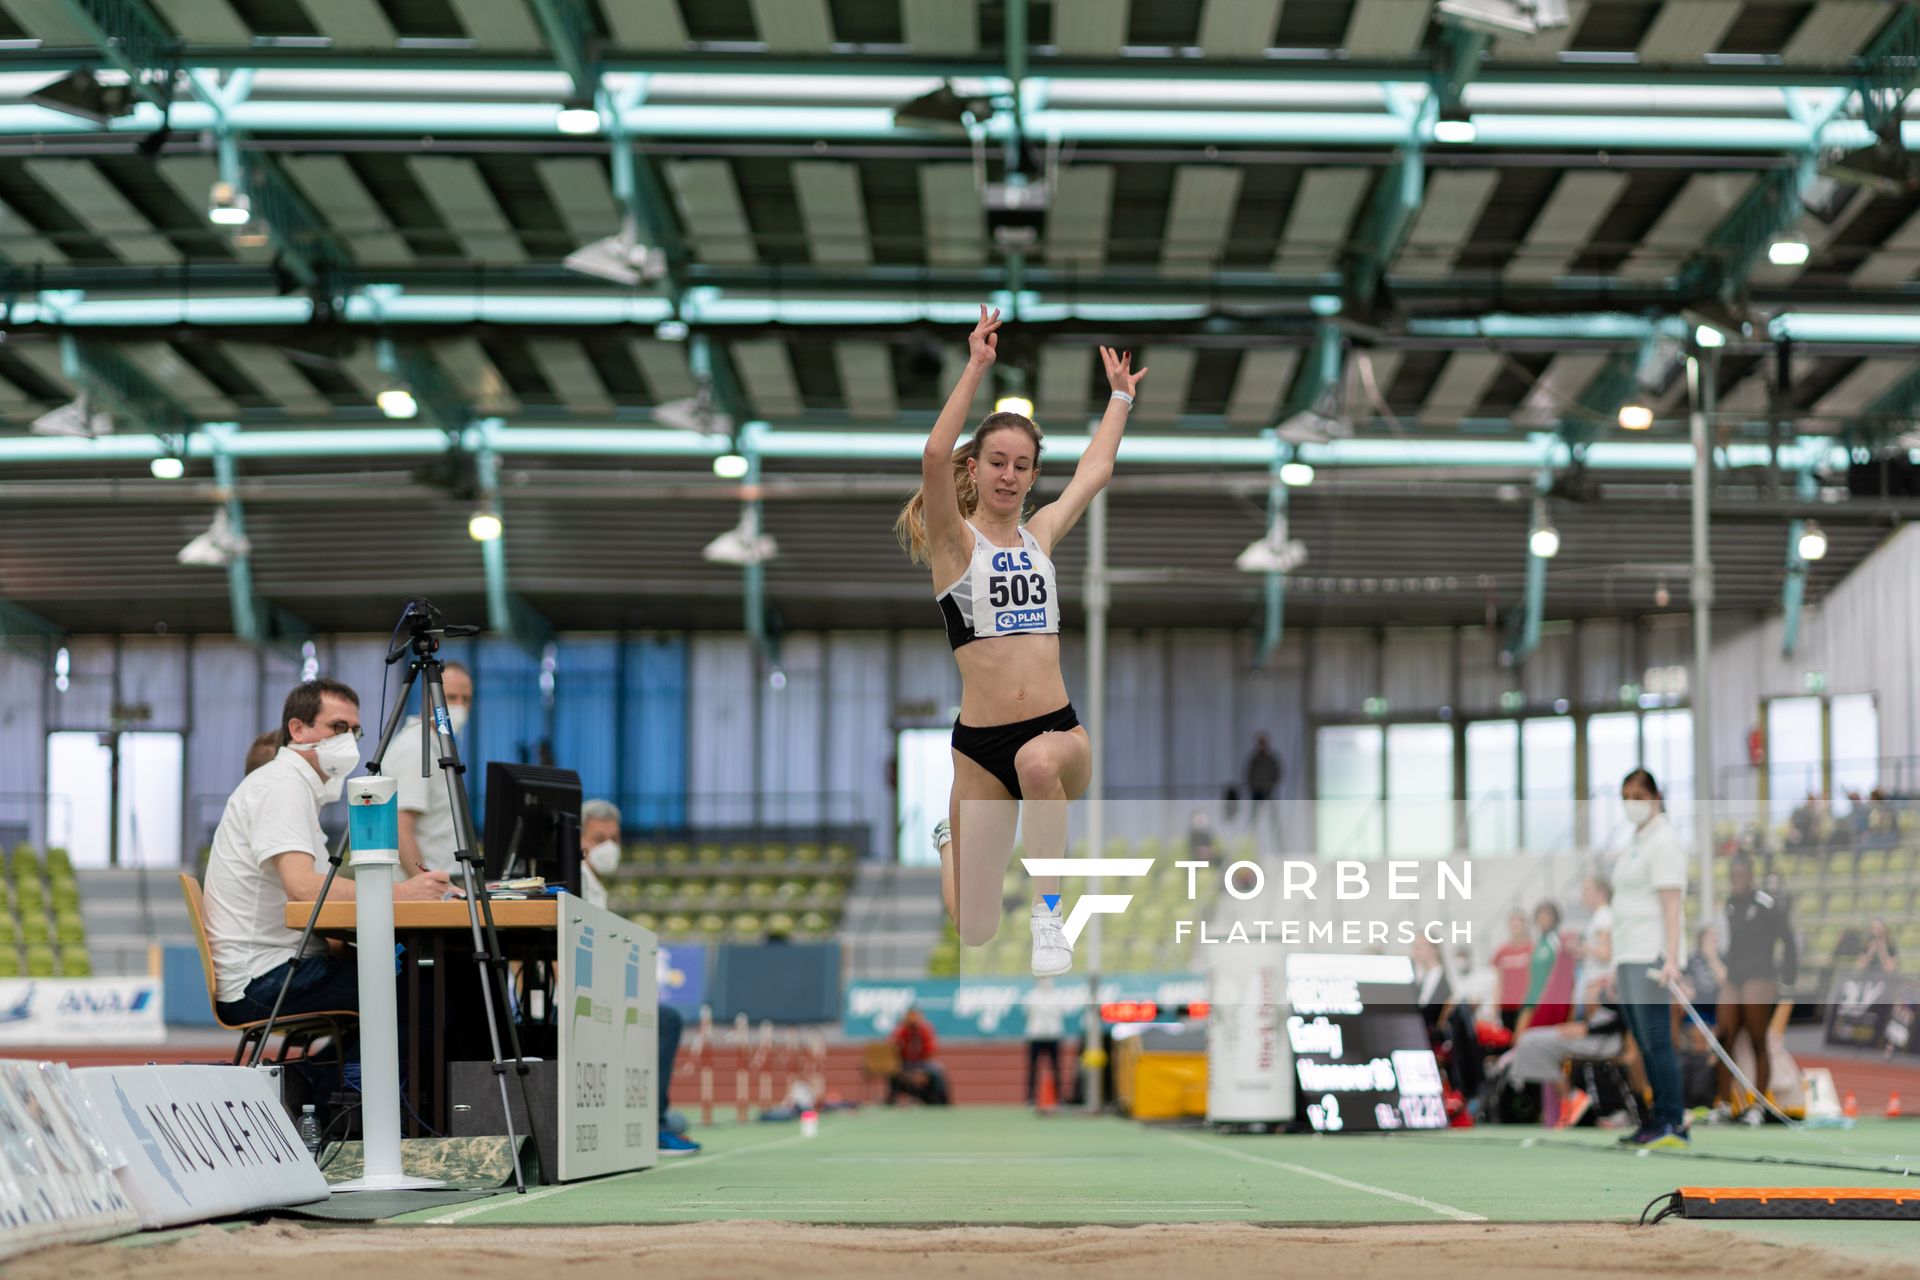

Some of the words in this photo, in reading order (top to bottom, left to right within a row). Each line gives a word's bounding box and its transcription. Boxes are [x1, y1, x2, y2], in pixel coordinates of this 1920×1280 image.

[989, 573, 1047, 608] 503
[1017, 612, 1044, 622] PLAN
[58, 988, 125, 1013] ANA
[145, 1100, 300, 1174] NOVAFON
